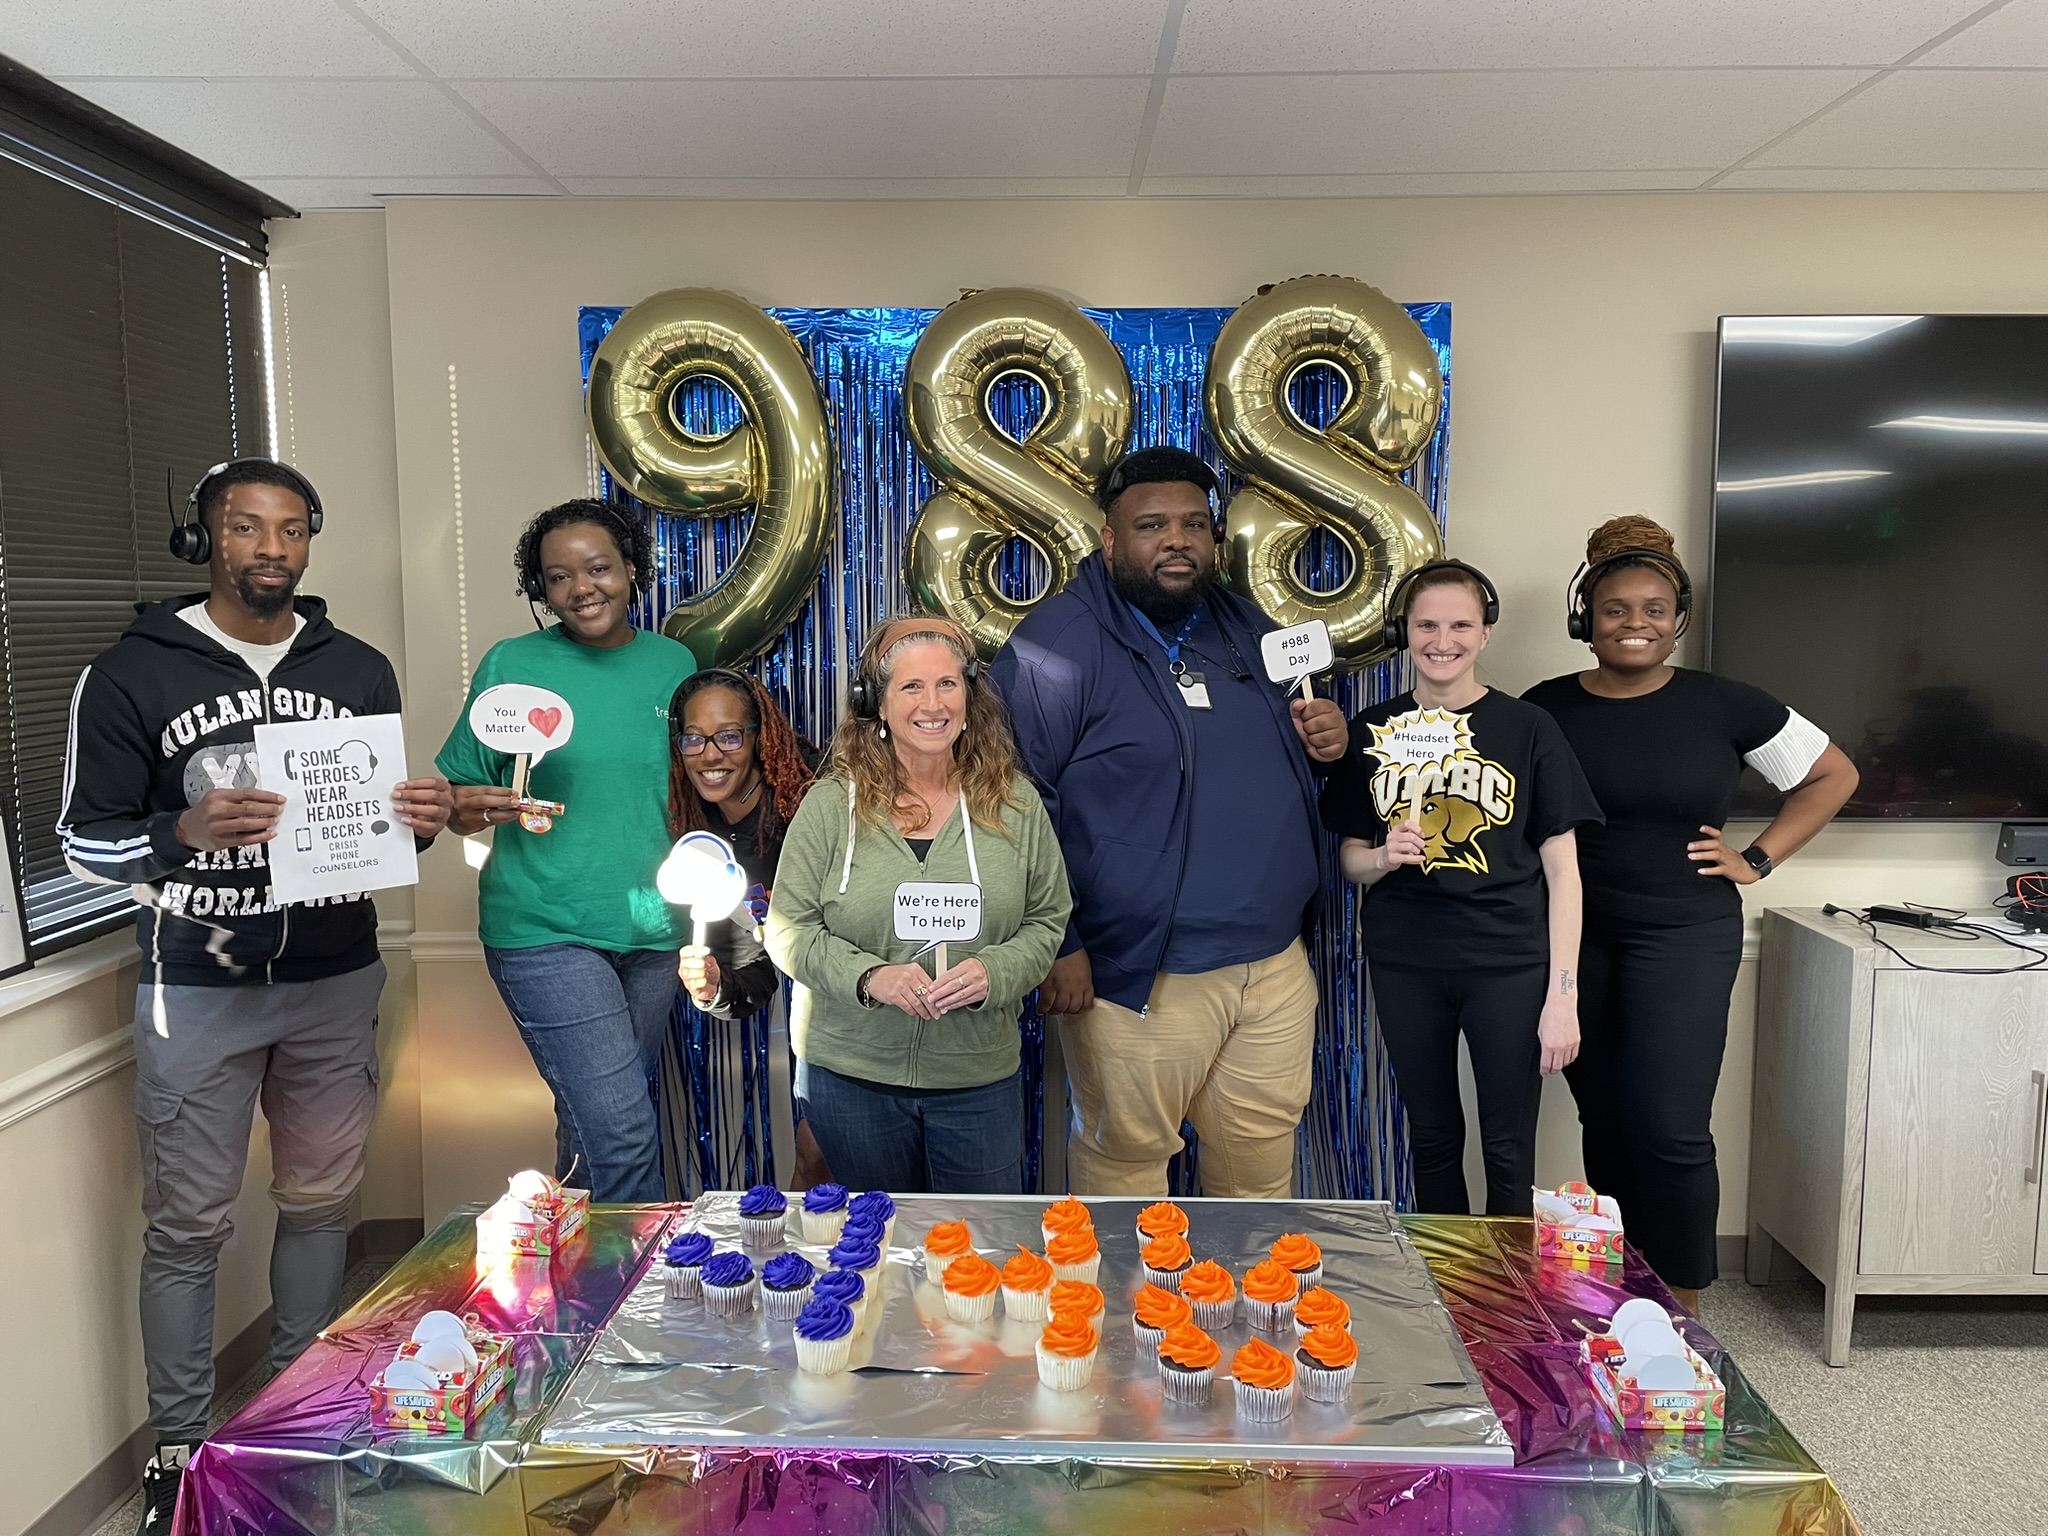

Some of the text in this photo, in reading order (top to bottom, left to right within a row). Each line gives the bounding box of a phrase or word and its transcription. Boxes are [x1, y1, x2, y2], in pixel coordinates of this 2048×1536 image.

[1281, 633, 1311, 650] #988
[1288, 652, 1311, 667] Day
[493, 707, 517, 718] You
[655, 705, 670, 719] tre
[485, 723, 527, 733] Matter
[1393, 732, 1450, 744] #Headset
[300, 749, 342, 768] SOME
[1406, 749, 1435, 759] Hero
[302, 765, 360, 786] HEROES
[304, 785, 348, 805] WEAR
[306, 800, 381, 823] HEADSETS
[321, 822, 364, 840] BCCRS
[328, 839, 359, 851] CRISIS
[330, 850, 360, 861] PHONE
[312, 858, 379, 874] COUNSELORS
[898, 895, 979, 908] We’re Here
[909, 915, 966, 931] To Help
